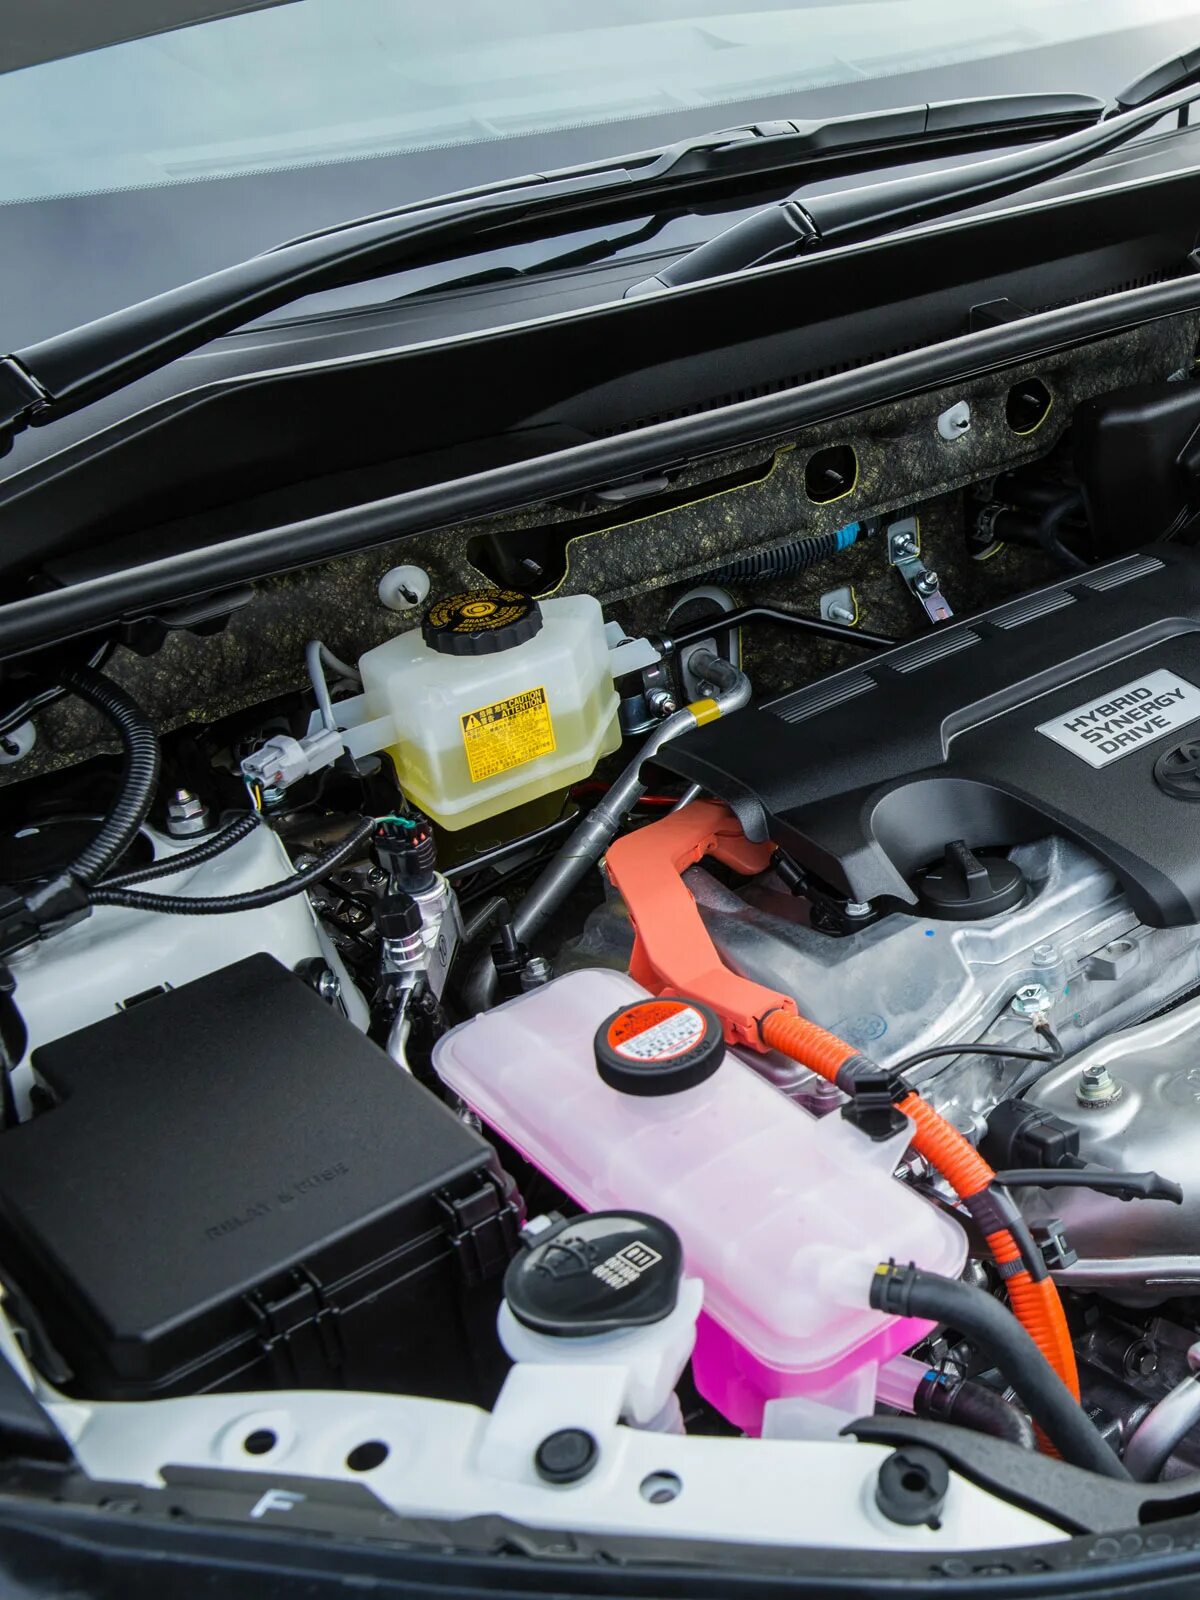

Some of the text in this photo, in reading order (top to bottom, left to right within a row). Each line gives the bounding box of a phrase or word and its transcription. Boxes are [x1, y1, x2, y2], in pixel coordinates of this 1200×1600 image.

[463, 615, 491, 624] BRAKE
[502, 697, 543, 718] ATTENTION
[508, 689, 542, 708] CAUTION
[1063, 687, 1153, 732] HYBRID
[1080, 687, 1187, 744] SYNERGY
[1097, 715, 1172, 755] DRIVE
[205, 1202, 272, 1241] RELAY
[294, 1162, 350, 1195] FUSE
[249, 1488, 307, 1519] F
